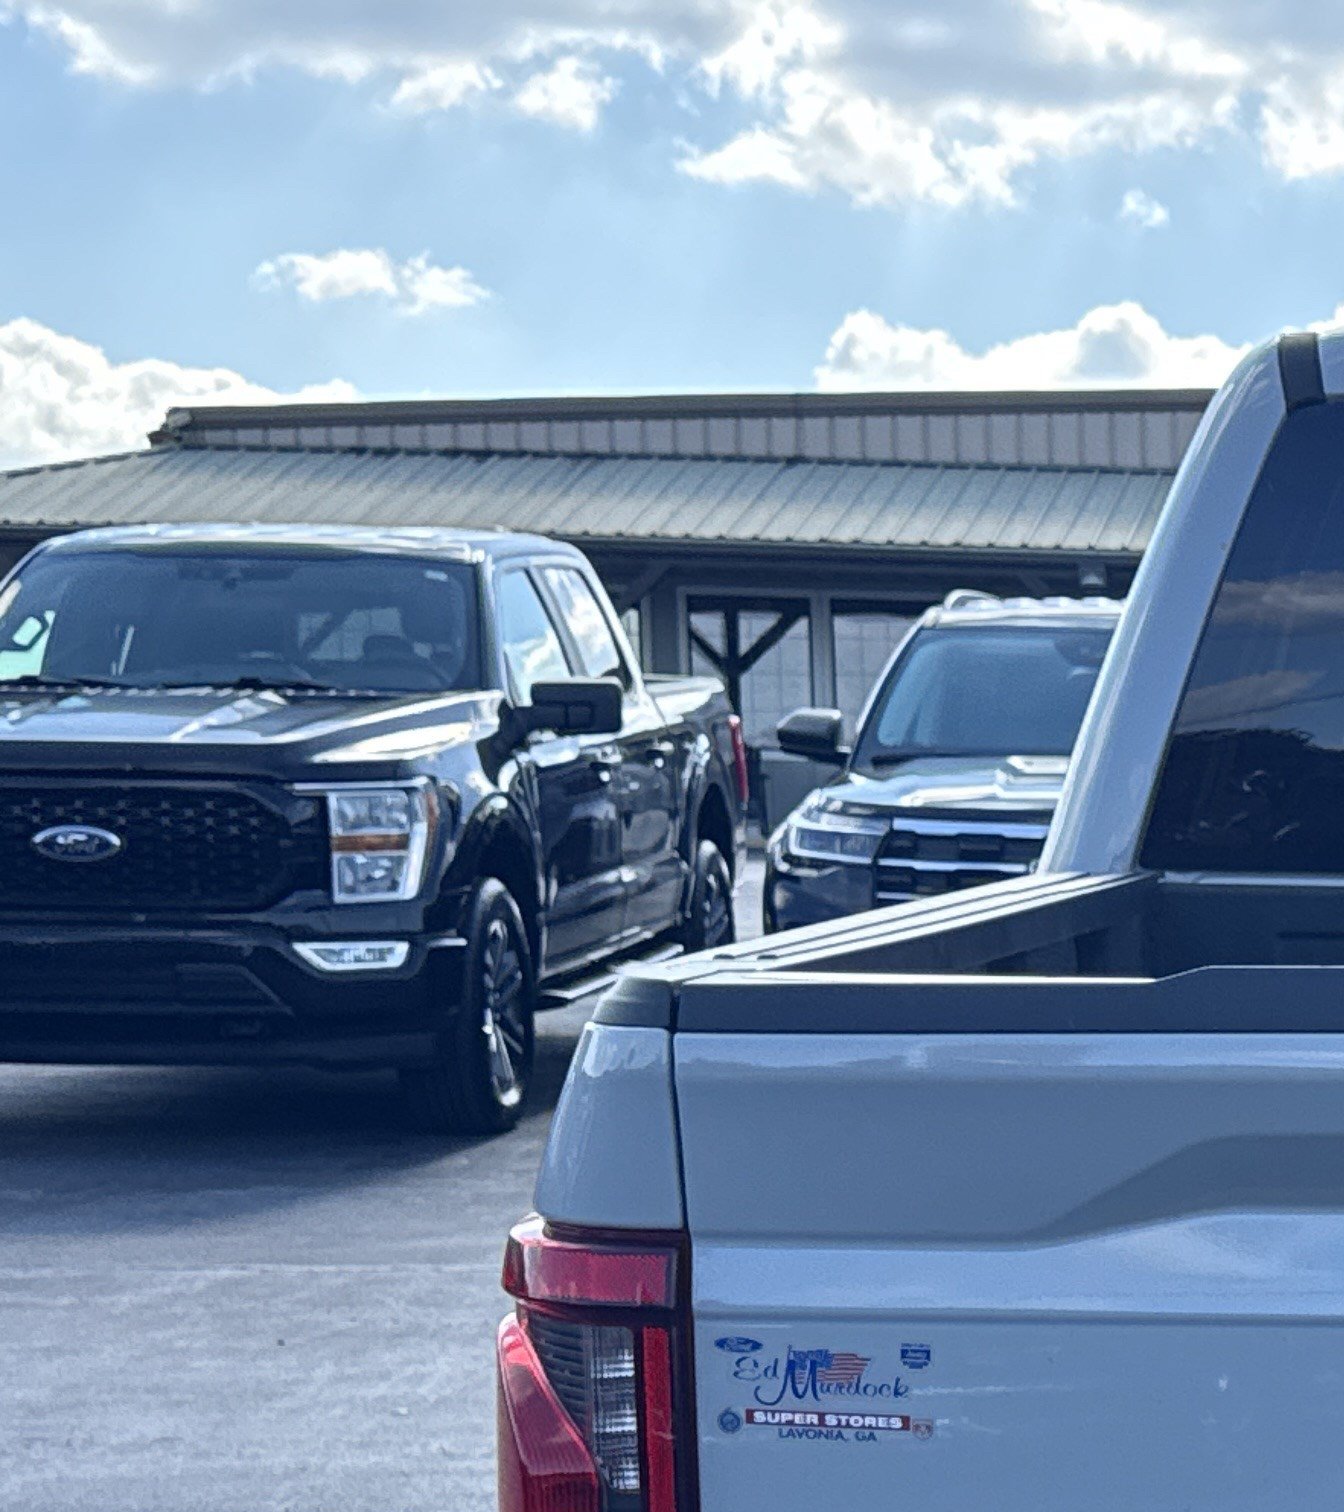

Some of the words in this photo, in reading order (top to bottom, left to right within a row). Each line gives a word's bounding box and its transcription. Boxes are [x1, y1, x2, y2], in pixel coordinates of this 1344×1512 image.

[733, 1357, 779, 1381] Ed
[754, 1352, 909, 1406] Murdock
[753, 1411, 819, 1426] SUPER
[824, 1414, 903, 1429] STORES
[778, 1428, 848, 1443] LAVONIA,
[854, 1430, 877, 1442] GA
